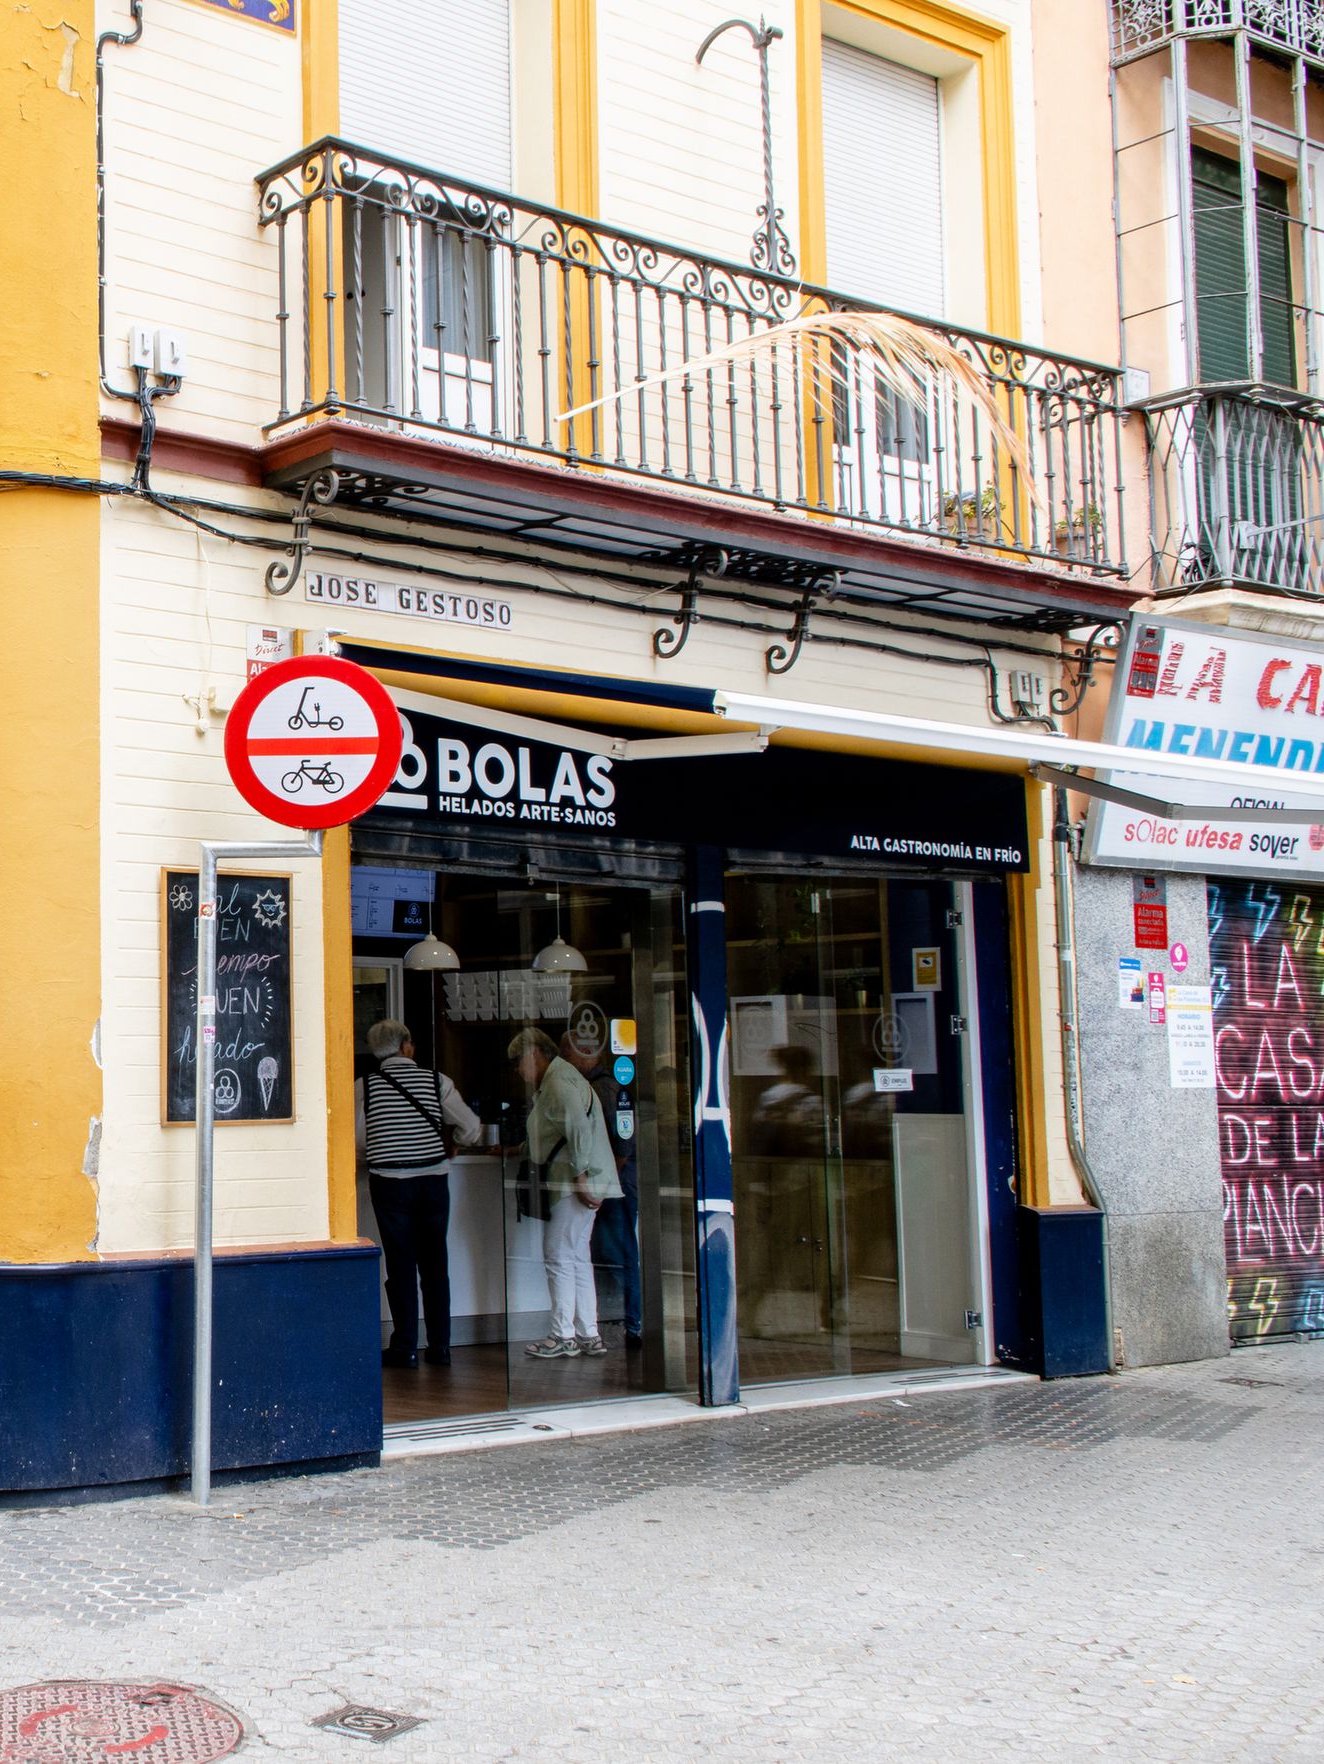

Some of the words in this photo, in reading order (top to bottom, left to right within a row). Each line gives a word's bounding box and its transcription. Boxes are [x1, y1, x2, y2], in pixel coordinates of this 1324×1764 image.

[309, 574, 377, 604] JOSE
[398, 588, 511, 625] GESTOSO
[256, 643, 285, 656] Direct
[1256, 658, 1324, 716] CA
[438, 737, 616, 809] BOLAS
[439, 796, 516, 818] HELADOS
[851, 835, 880, 851] ALTA
[883, 837, 973, 859] GASTRONOMÍA
[975, 847, 991, 861] EN
[994, 846, 1022, 863] FRÍO
[1185, 823, 1243, 850] ufesa
[1138, 907, 1163, 918] Alarma
[1242, 942, 1304, 1011] LA
[216, 987, 261, 1016] UEN
[1215, 1024, 1324, 1100] CAS
[1223, 1114, 1276, 1164] DE
